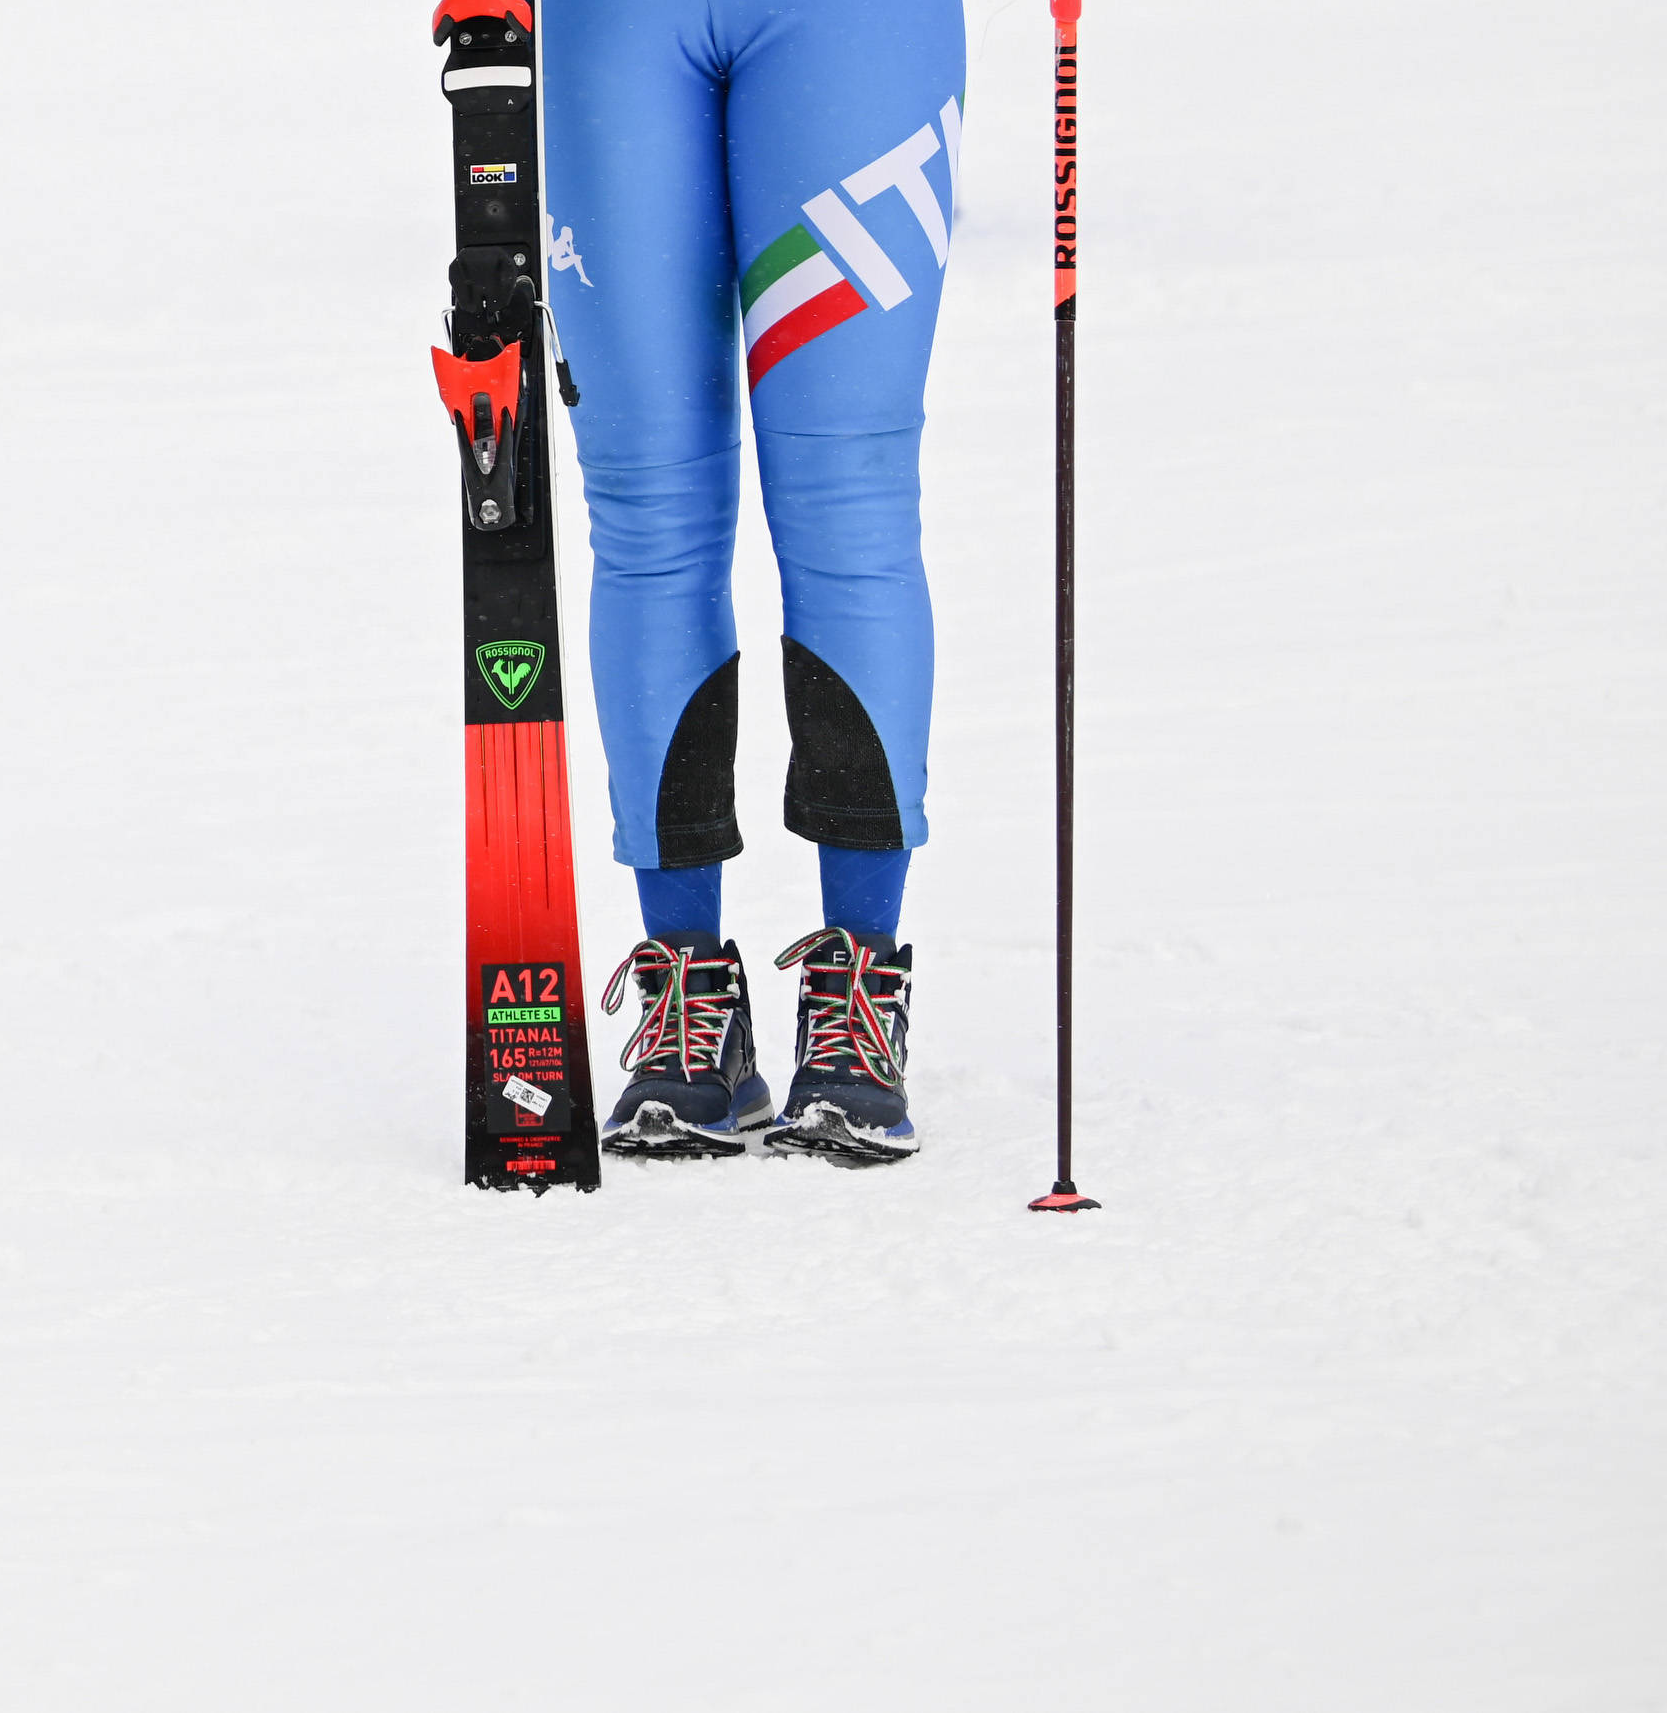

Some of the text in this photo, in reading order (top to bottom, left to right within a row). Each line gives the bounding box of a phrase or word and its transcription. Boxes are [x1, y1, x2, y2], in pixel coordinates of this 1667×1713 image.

[1055, 32, 1077, 271] ROSSIGNOL
[472, 173, 503, 183] LOOK
[484, 646, 536, 660] ROSSIGNOL
[490, 968, 560, 1004] A12
[491, 1009, 557, 1022] ATHLETE SL
[488, 1027, 563, 1044] TITANAL
[490, 1046, 563, 1069] 165 R=12M
[535, 1071, 564, 1081] TURN
